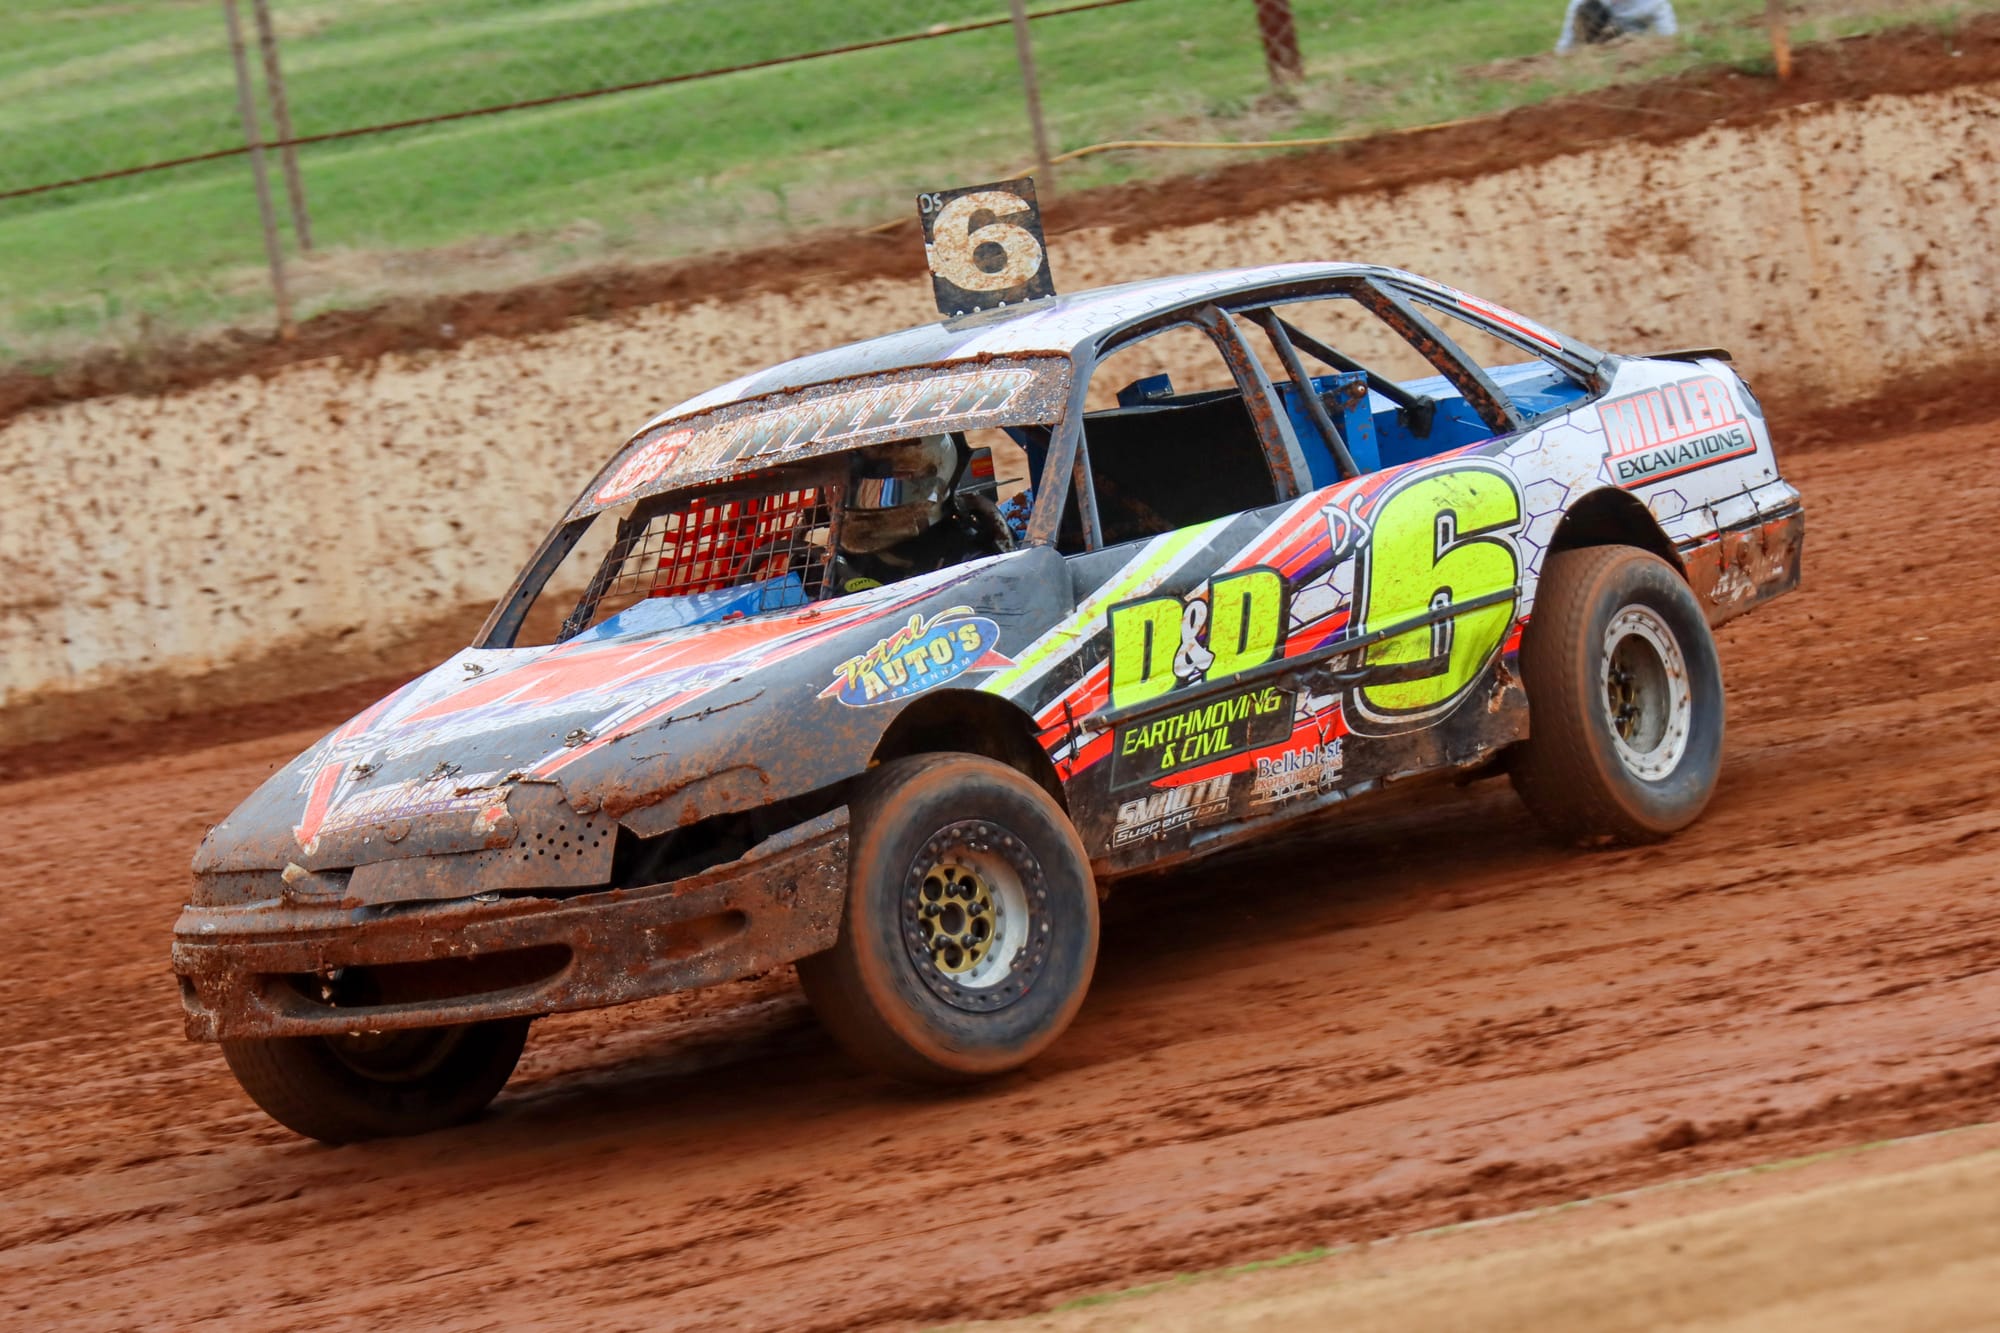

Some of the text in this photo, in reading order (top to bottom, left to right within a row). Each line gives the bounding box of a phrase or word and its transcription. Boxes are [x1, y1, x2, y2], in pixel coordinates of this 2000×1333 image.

[928, 190, 1043, 292] 6
[1598, 376, 1738, 455] MILLER
[1617, 427, 1745, 480] EXCAVATIONS
[1348, 464, 1525, 722] 6
[835, 606, 975, 690] Total
[862, 623, 982, 700] AUTO'S
[890, 656, 972, 699] PAKENHAM
[1110, 567, 1286, 712] D&D
[1121, 686, 1283, 757] EARTHMOVING
[1161, 725, 1233, 769] & CIVIL
